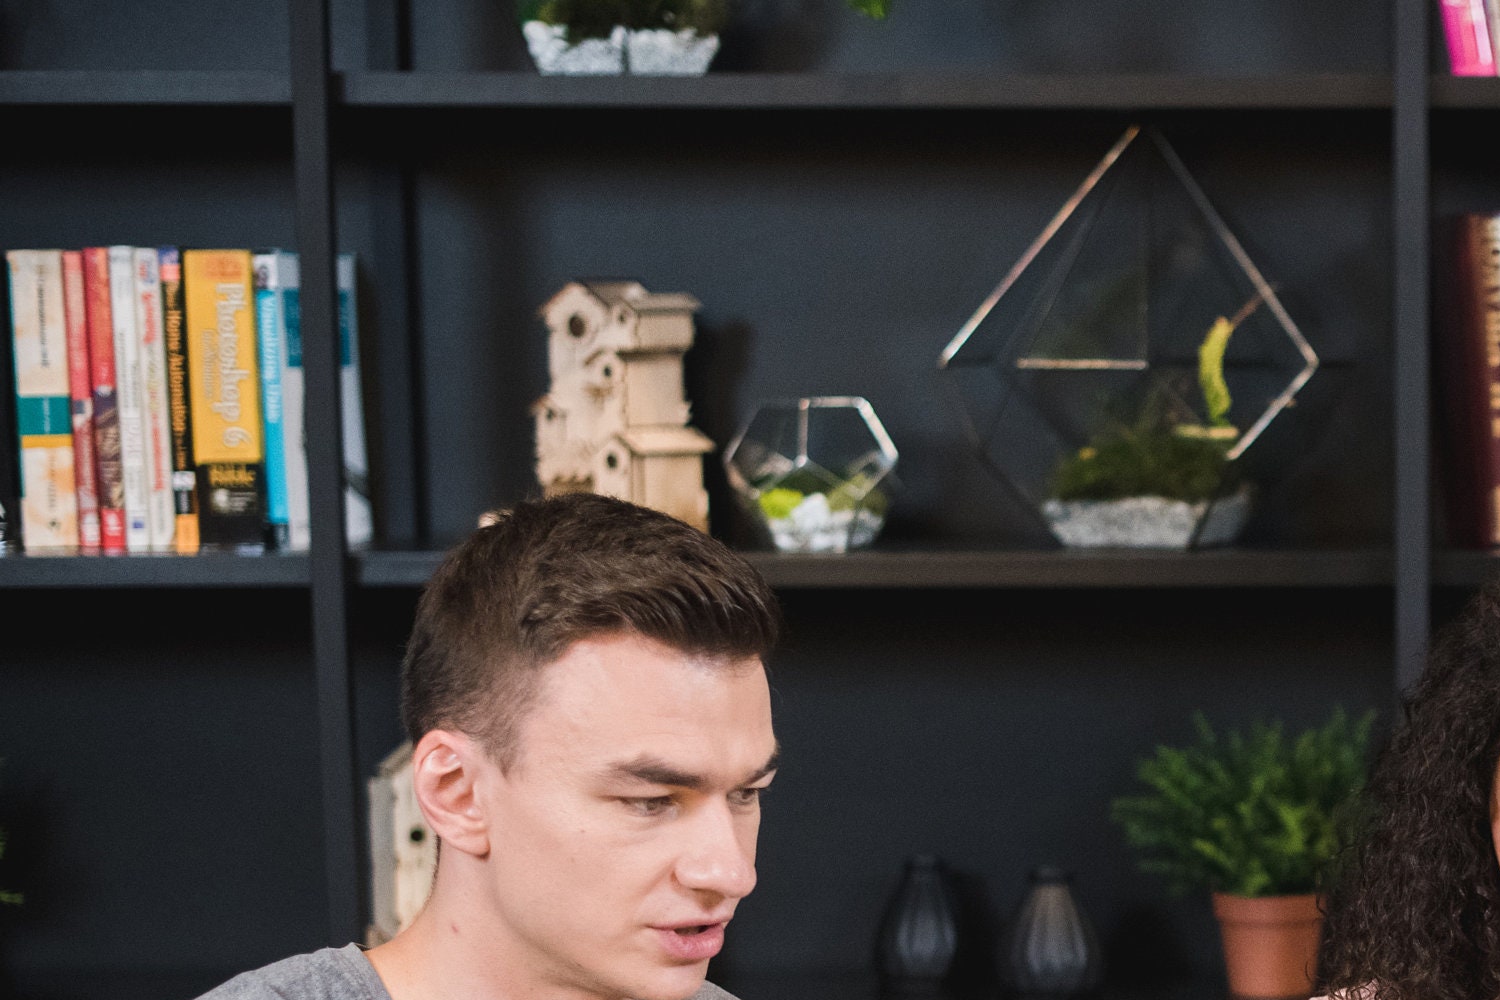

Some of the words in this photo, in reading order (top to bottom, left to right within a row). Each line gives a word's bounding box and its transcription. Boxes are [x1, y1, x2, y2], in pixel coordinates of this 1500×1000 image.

[213, 283, 249, 421] Photoshop
[169, 353, 187, 433] Automation
[222, 427, 252, 448] 6
